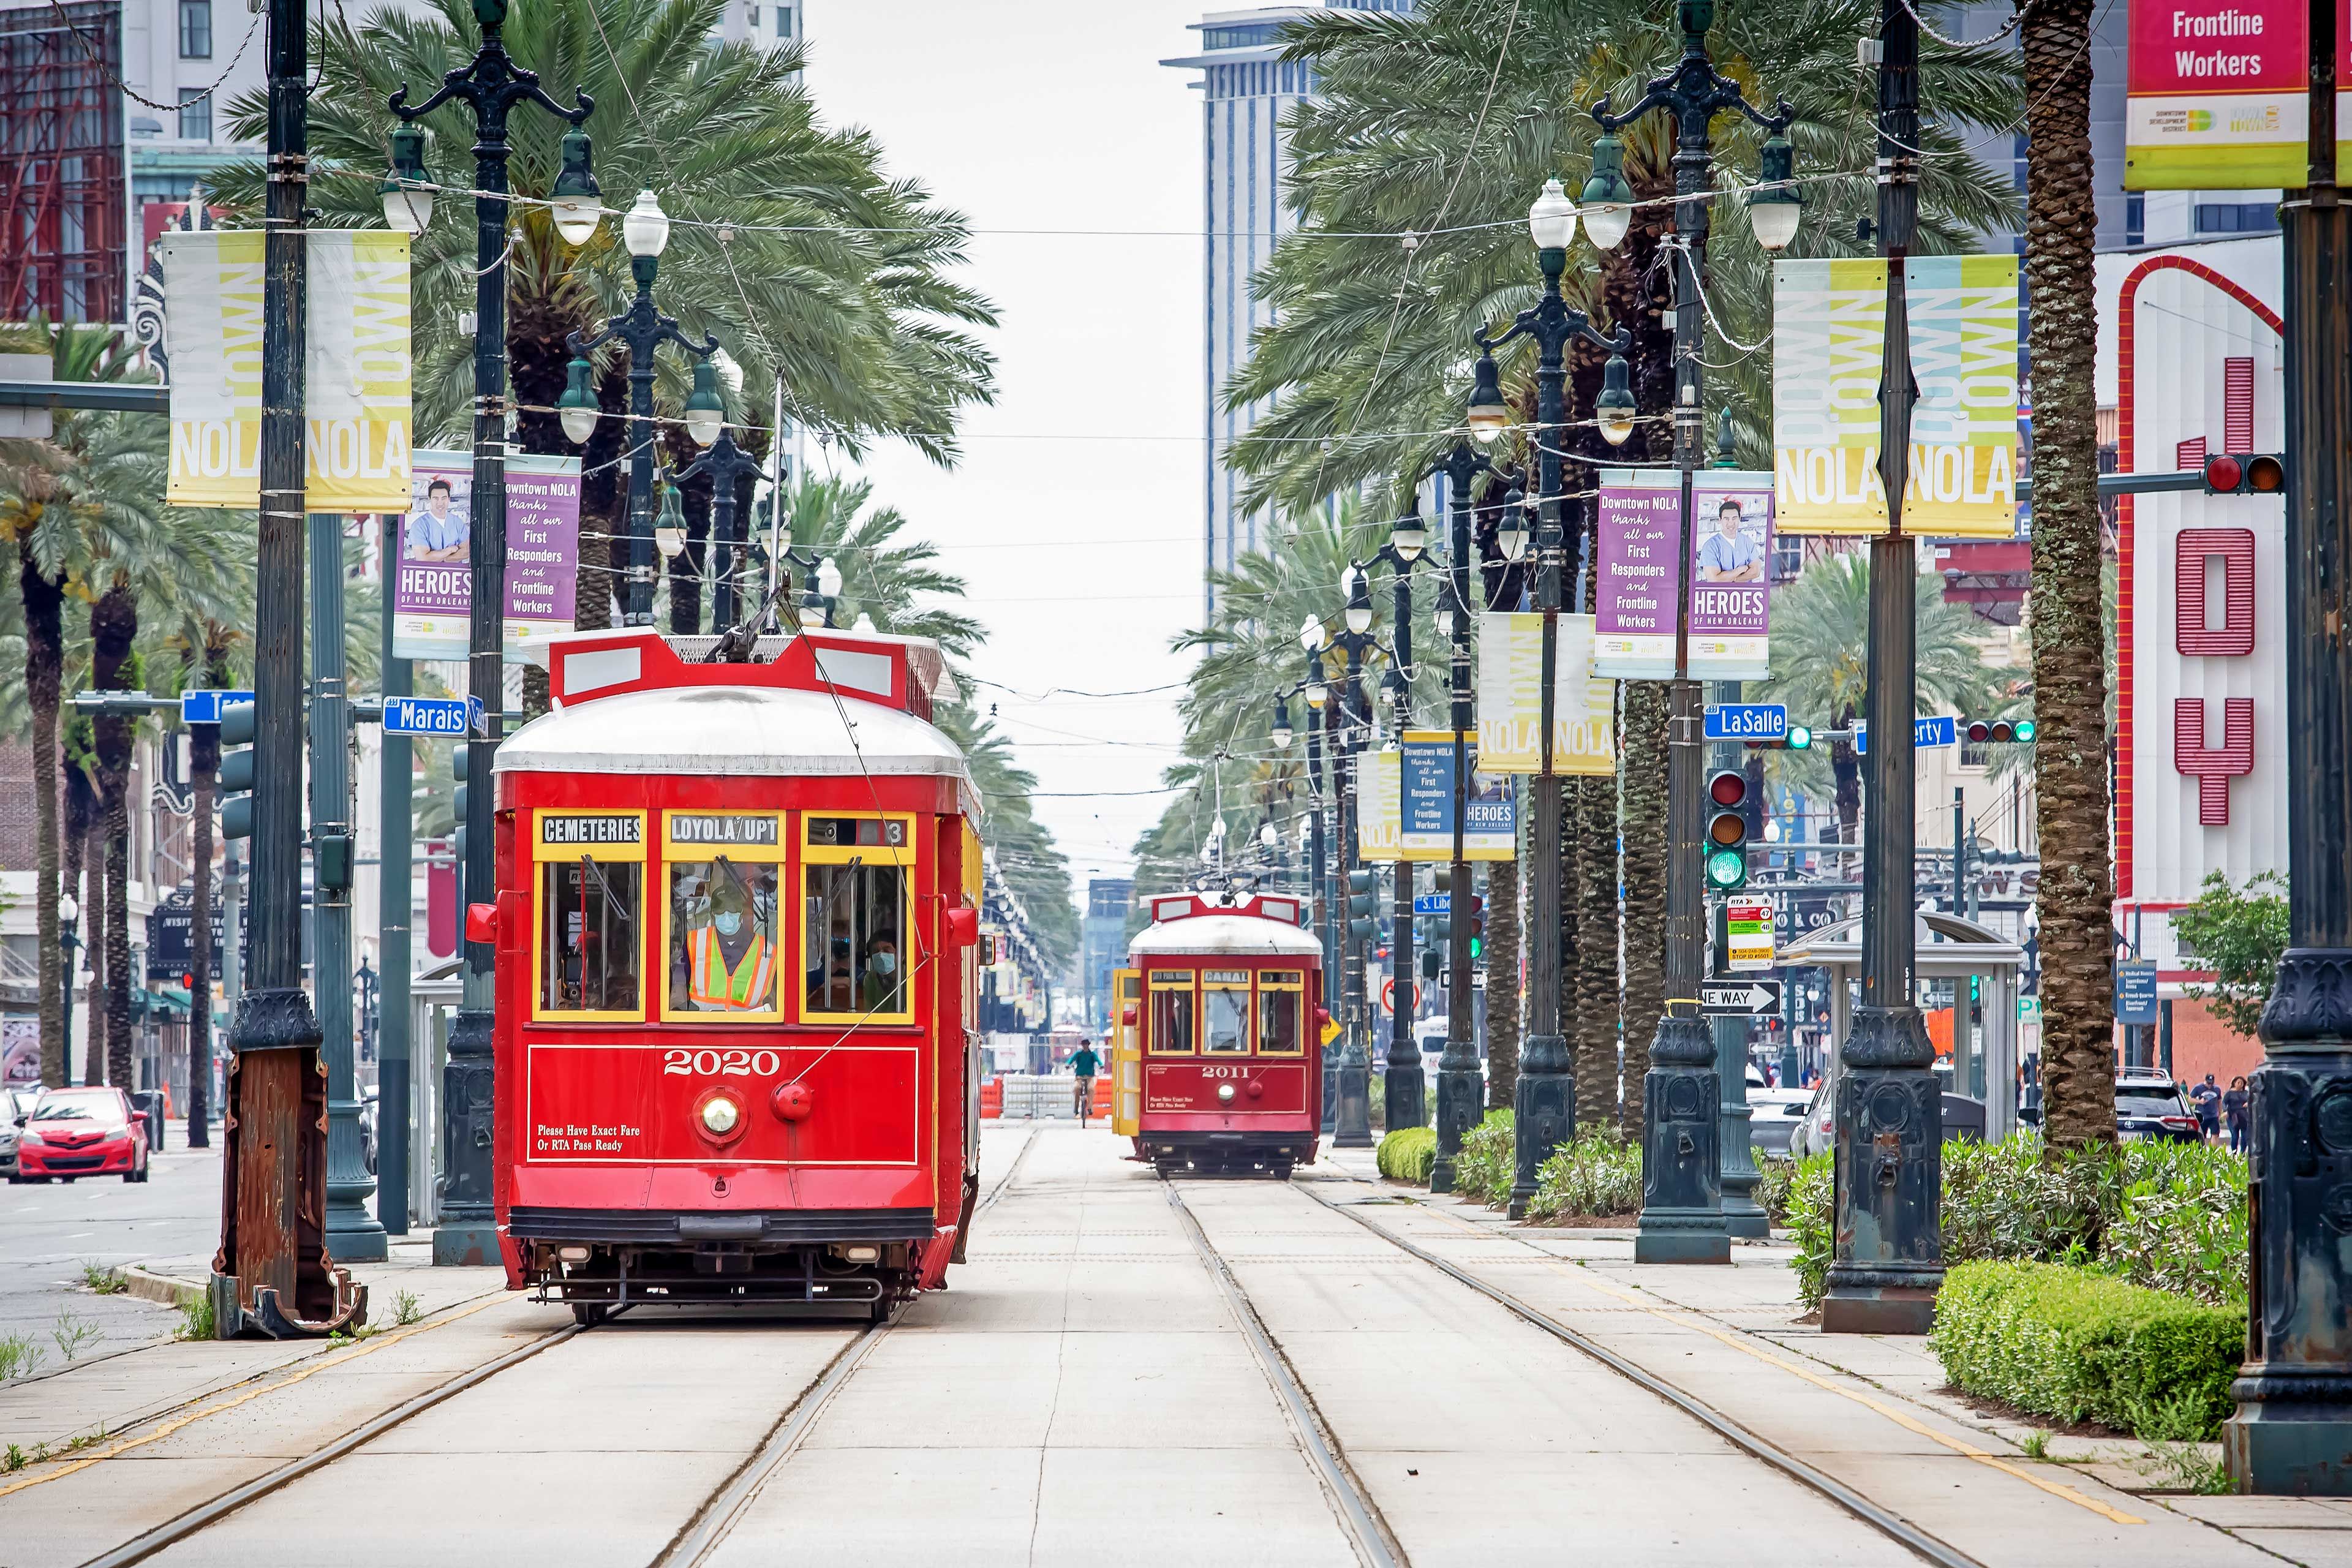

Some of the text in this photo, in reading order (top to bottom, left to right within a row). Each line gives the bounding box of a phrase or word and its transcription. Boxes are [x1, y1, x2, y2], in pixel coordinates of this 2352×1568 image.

[2173, 9, 2264, 37] Frontline
[2175, 50, 2262, 78] Workers
[352, 262, 410, 418] TOWN
[1829, 290, 1888, 445] TOWN
[1904, 287, 1962, 442] DOWN
[1960, 287, 2019, 442] TOWN
[171, 420, 262, 478] NOL
[306, 419, 410, 479] NOLA
[1777, 445, 1885, 505] NOLA
[1905, 443, 2015, 505] NOLA
[505, 483, 576, 497] owntown NOLA
[508, 499, 548, 511] thanks
[1602, 496, 1678, 510] Downtown NOLA
[520, 513, 563, 526] all our
[1611, 514, 1650, 526] thanks
[524, 529, 548, 544] First
[1623, 529, 1665, 540] all our
[507, 547, 562, 564] Responders
[1627, 545, 1650, 558] First
[522, 567, 546, 577] and
[1611, 562, 1665, 578] Responders
[401, 569, 472, 595] HEROES
[512, 580, 554, 595] Frontline
[1626, 581, 1649, 592] and
[401, 595, 410, 603] OF
[513, 598, 552, 614] Workers
[1616, 596, 1657, 610] Frontline
[1694, 591, 1764, 616] HEROES
[1617, 614, 1656, 628] Workers
[1727, 617, 1763, 626] ORLEANS
[400, 701, 463, 731] Marais
[1479, 720, 1541, 755] NOLA
[1555, 720, 1615, 757] NOLA
[1404, 747, 1453, 756] Downtown NOLA
[1421, 777, 1436, 786] First
[1411, 789, 1446, 799] Responders
[1414, 809, 1441, 818] Frontline
[1467, 806, 1512, 821] HEROES
[544, 817, 640, 843] CEMETERIES
[888, 822, 902, 843] 3
[1415, 821, 1441, 829] Workers
[1360, 824, 1401, 848] NOLA
[1423, 897, 1431, 910] S.
[1702, 992, 1751, 1005] NE WAY
[663, 1049, 780, 1076] 2020
[1202, 1066, 1250, 1079] 2011
[537, 1125, 640, 1136] Please Have Exact Fare
[537, 1139, 623, 1152] Or RTA Pass Ready
